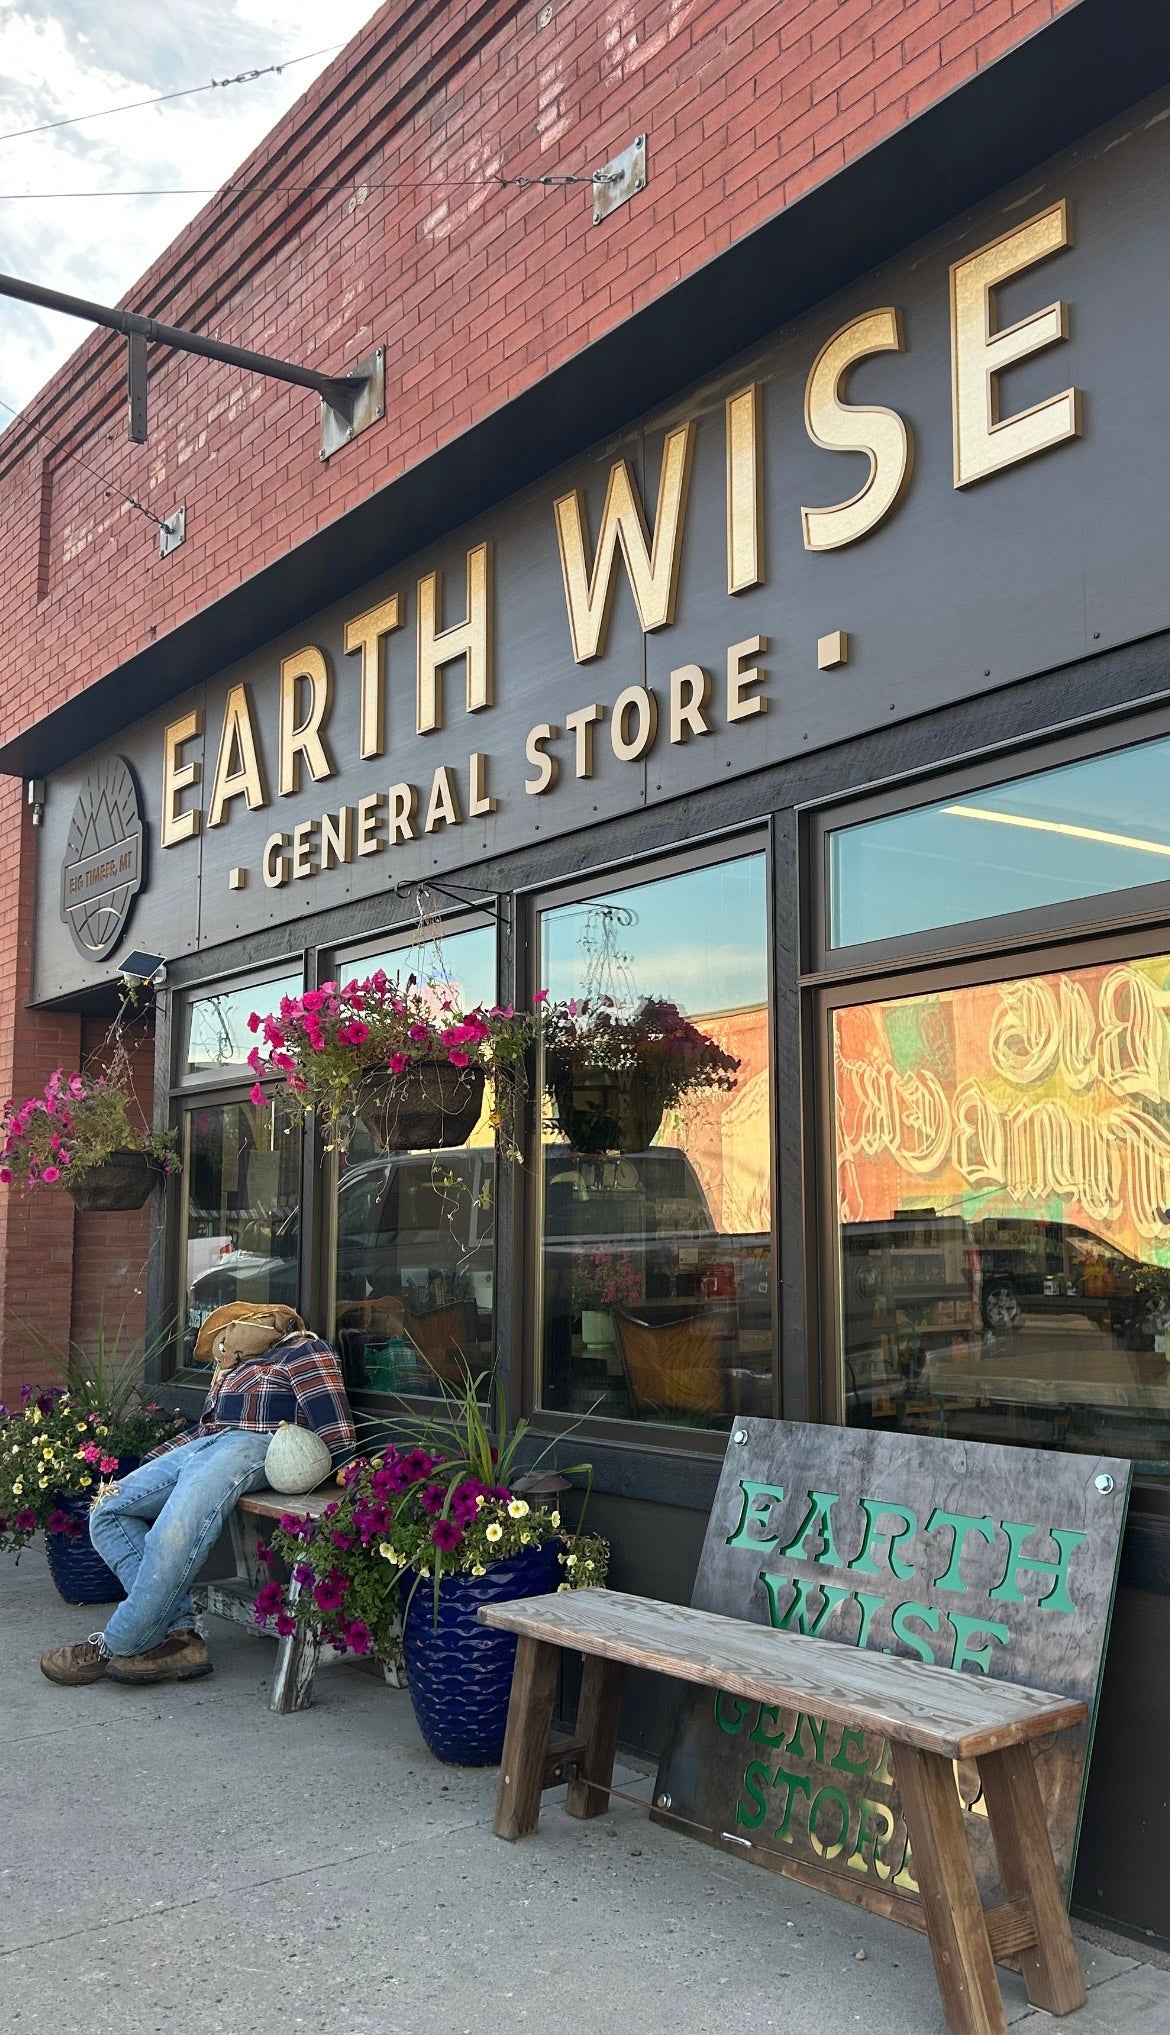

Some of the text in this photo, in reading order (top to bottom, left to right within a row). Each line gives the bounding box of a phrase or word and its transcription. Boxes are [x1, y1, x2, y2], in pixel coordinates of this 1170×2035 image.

[160, 198, 1083, 848] EARTH WISE
[262, 634, 768, 888] GENERAL STORE
[70, 875, 83, 894] BIG
[119, 851, 132, 872] MT
[726, 1480, 1088, 1614] EARTH
